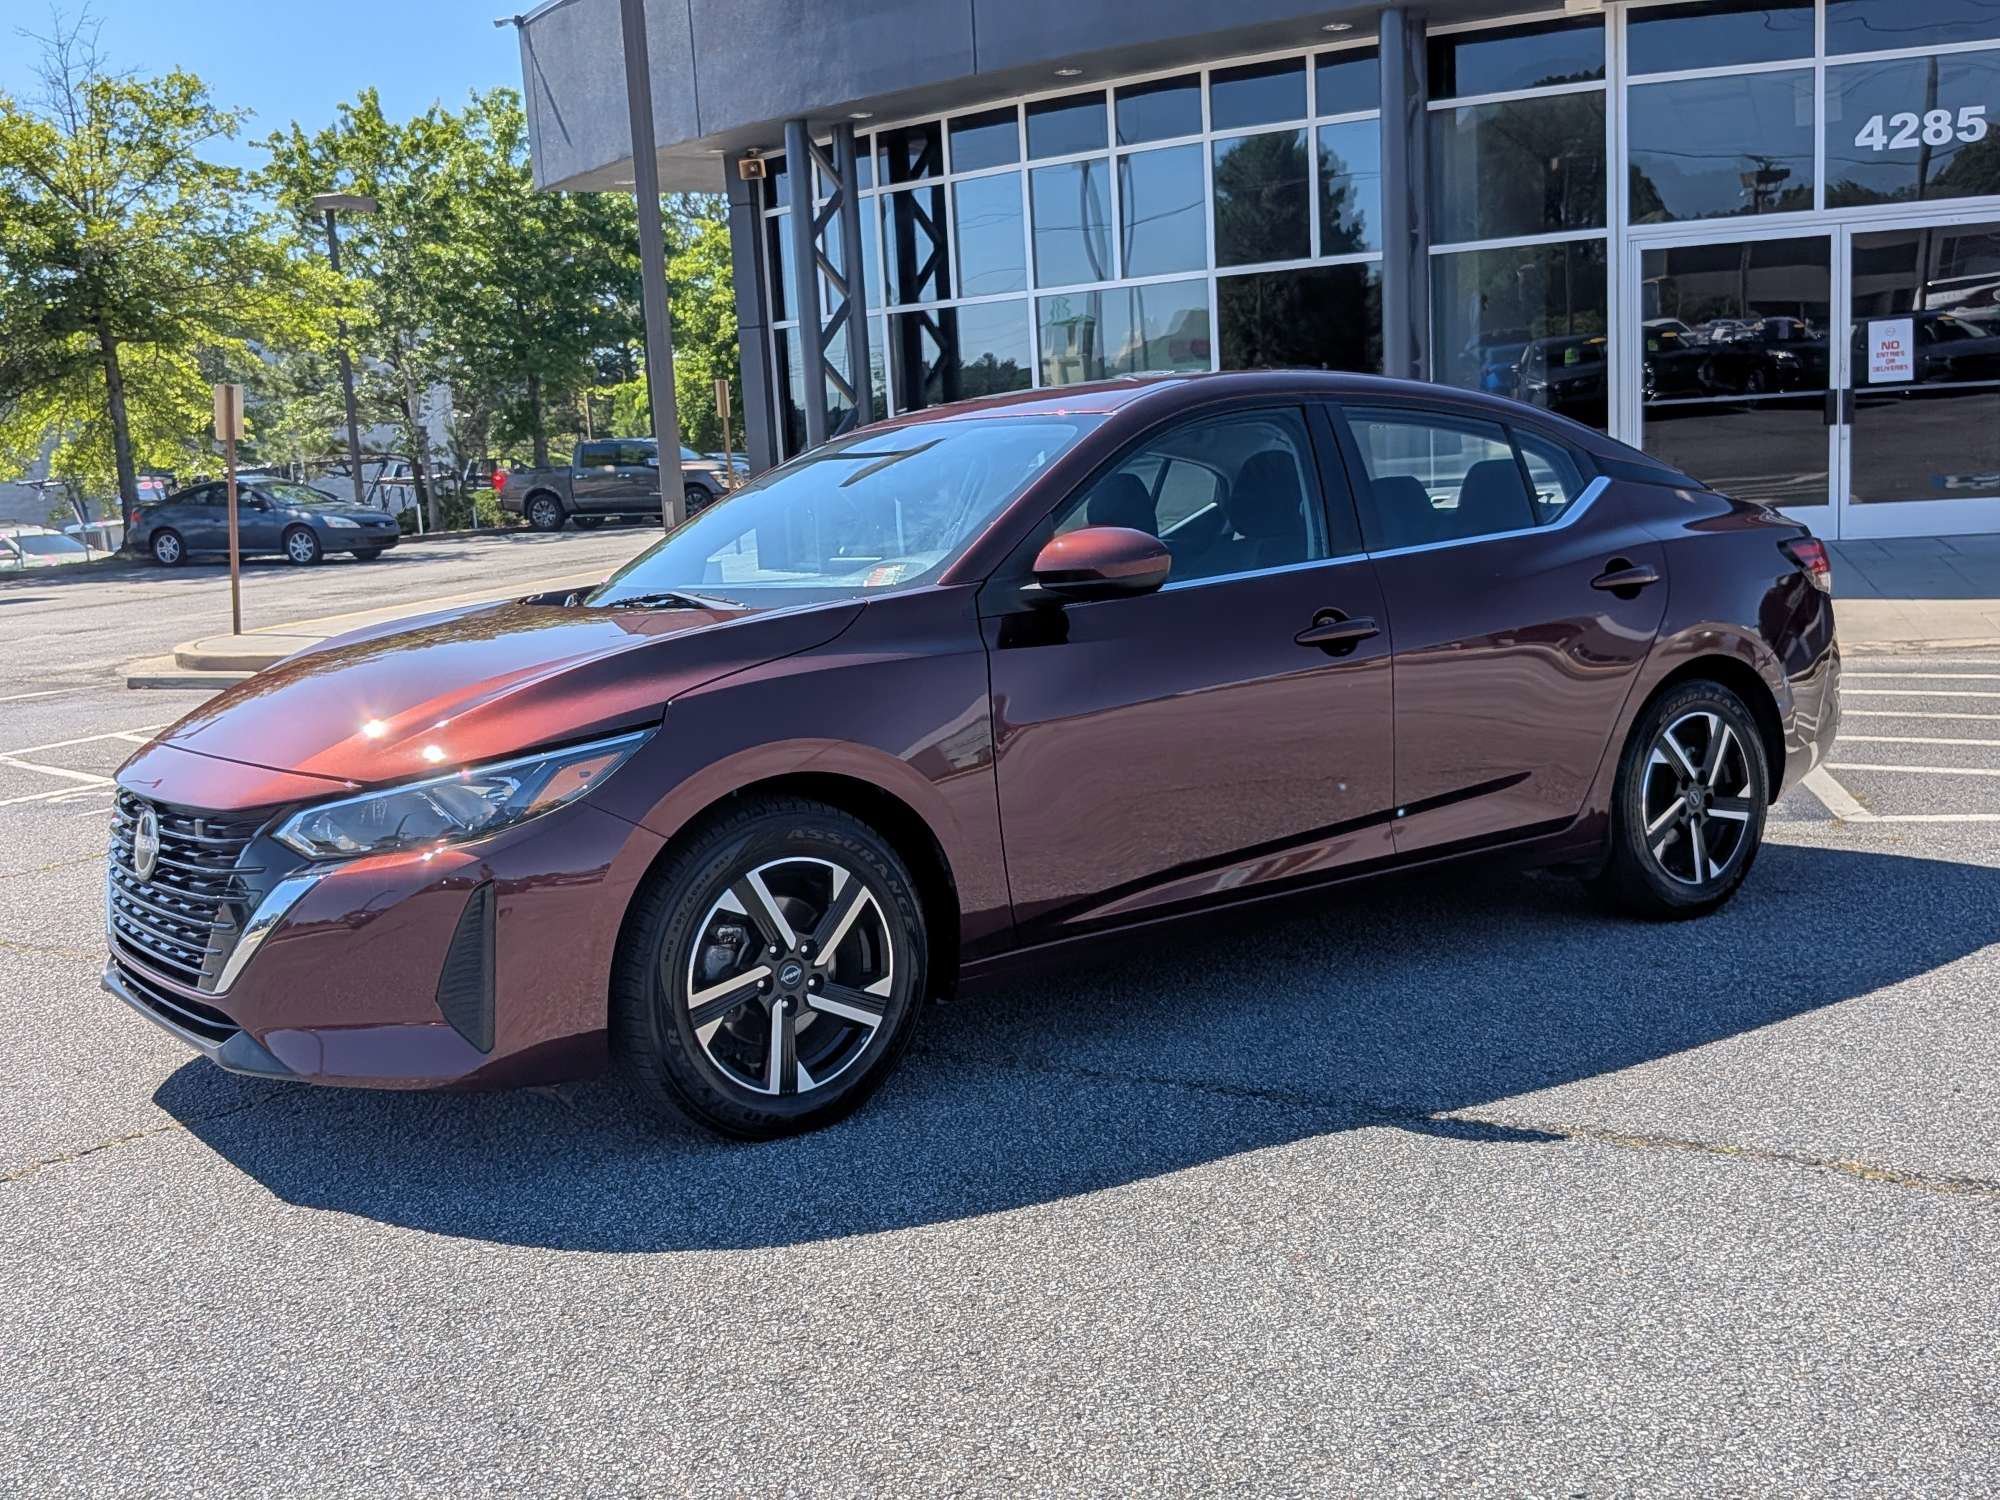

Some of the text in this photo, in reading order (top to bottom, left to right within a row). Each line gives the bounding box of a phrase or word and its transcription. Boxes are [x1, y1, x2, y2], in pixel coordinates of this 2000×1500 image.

[1854, 105, 1988, 151] 4285
[1881, 340, 1900, 350] NO
[1876, 351, 1905, 359] ENTRIES
[1872, 364, 1908, 372] DELIVERIES
[786, 828, 916, 935] ASSURANCE
